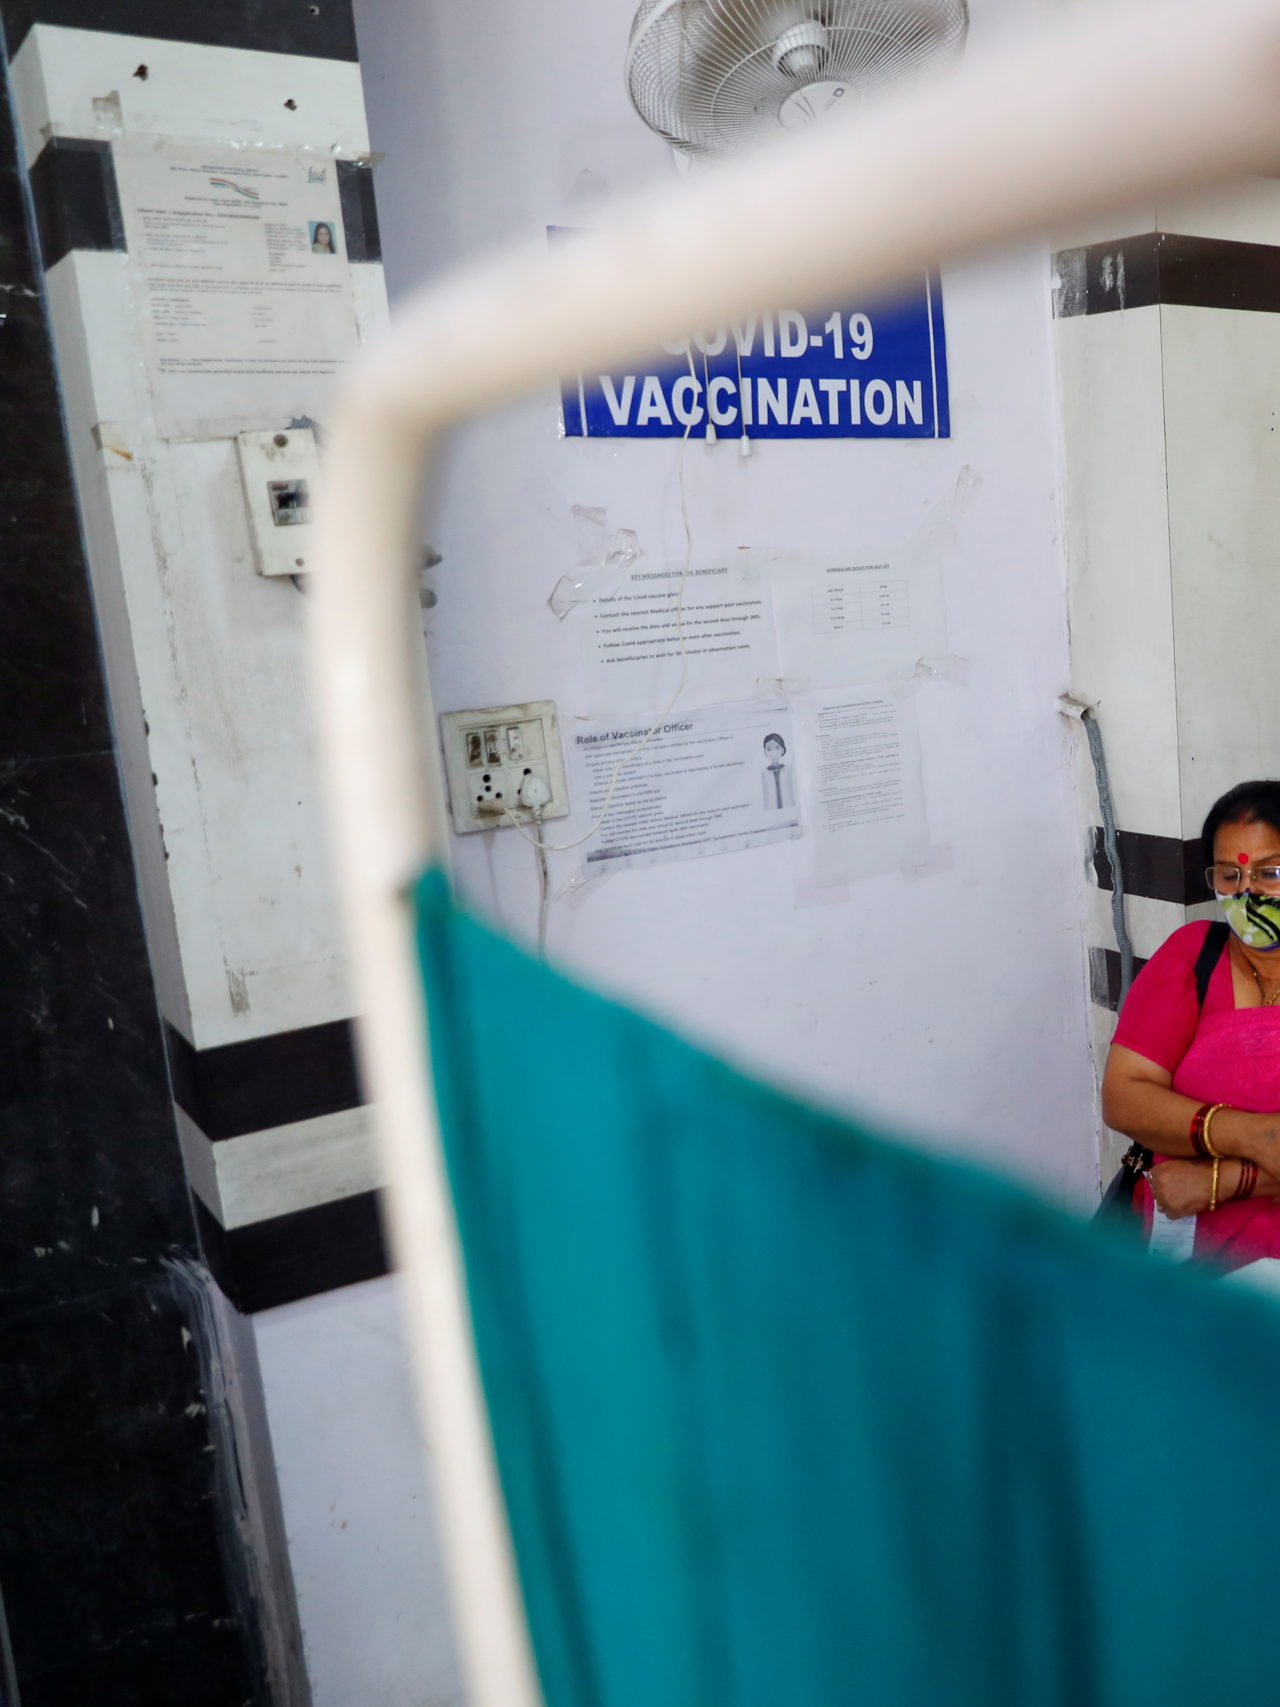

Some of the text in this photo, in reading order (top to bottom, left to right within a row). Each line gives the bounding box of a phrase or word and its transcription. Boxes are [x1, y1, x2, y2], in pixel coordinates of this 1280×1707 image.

[598, 375, 923, 426] VACCINATION
[576, 735, 598, 745] Role
[600, 732, 609, 741] of
[663, 722, 694, 734] Officer
